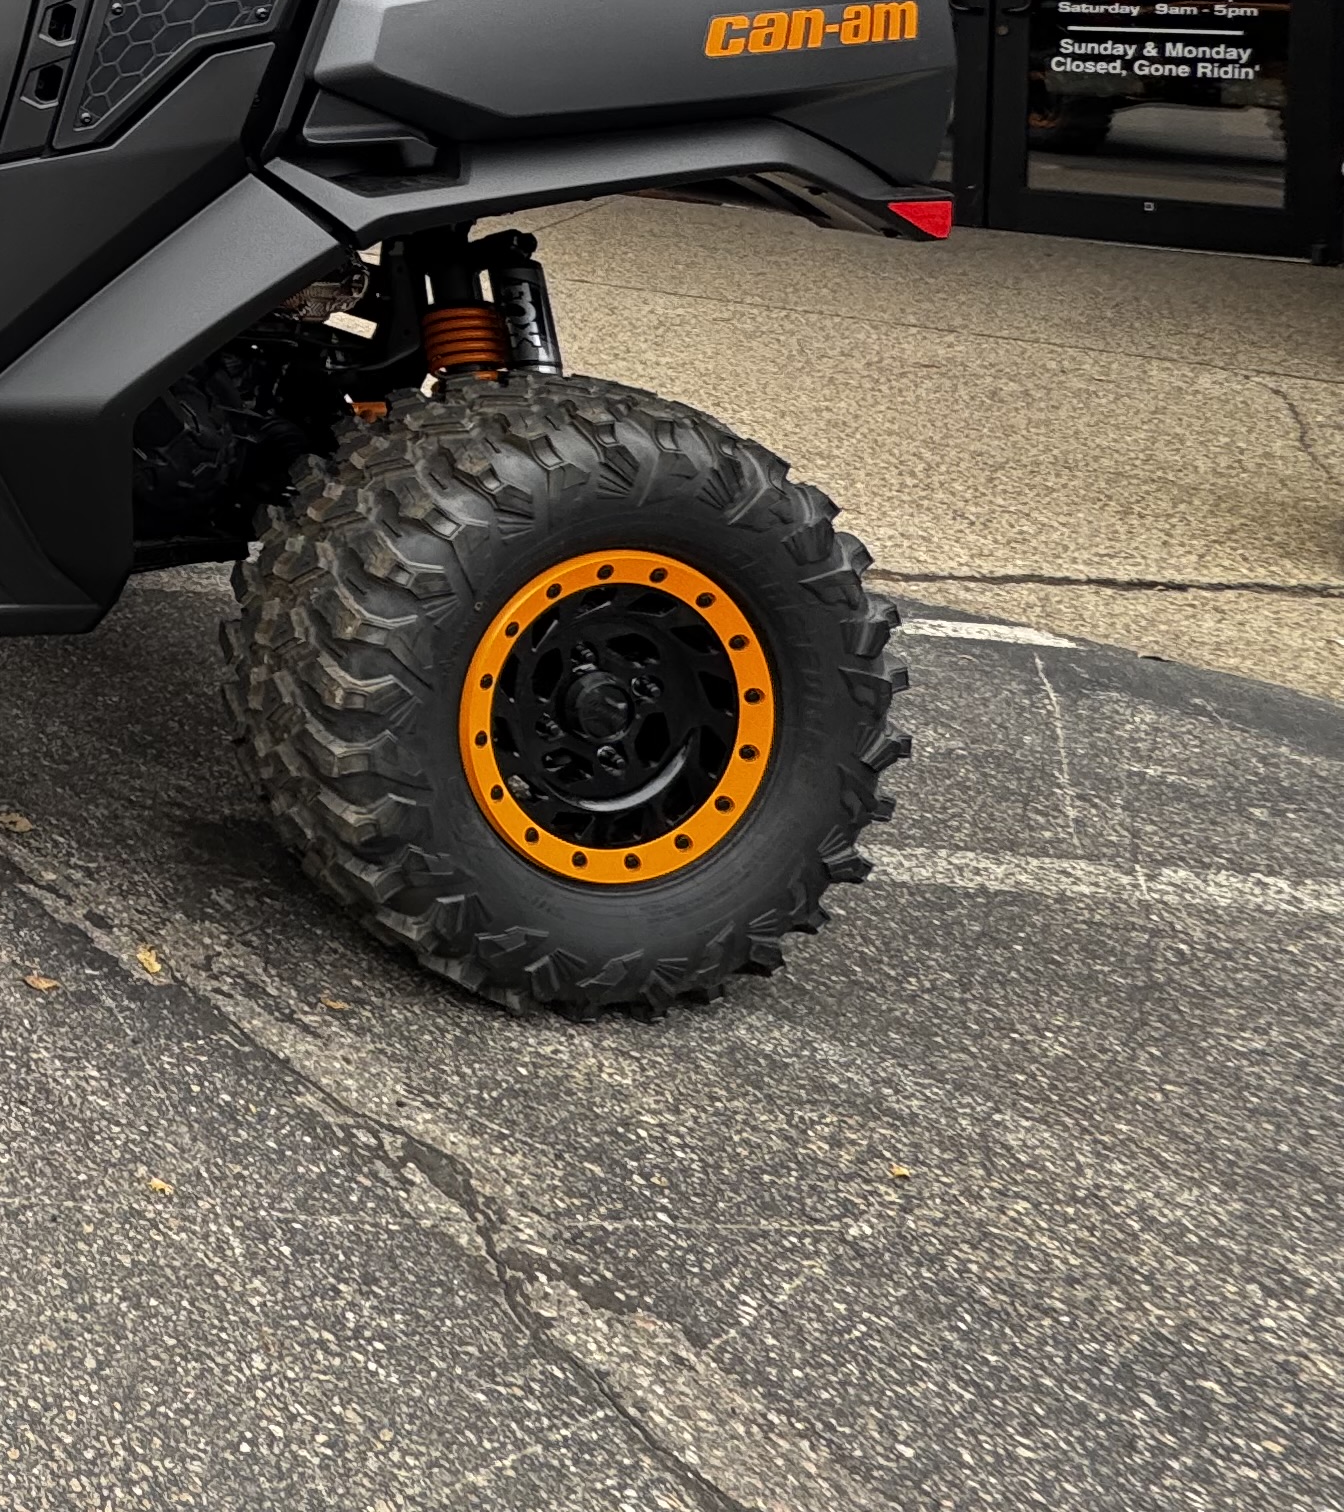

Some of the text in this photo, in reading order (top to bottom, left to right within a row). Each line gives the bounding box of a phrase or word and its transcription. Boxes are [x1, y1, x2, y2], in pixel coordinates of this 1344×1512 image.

[1058, 1, 1140, 16] Saturday
[1155, 4, 1198, 15] 9am
[1214, 4, 1259, 18] 5pm
[705, 0, 918, 57] can-am
[1059, 39, 1252, 63] Sunday & Monday
[1050, 56, 1128, 76] Closed,
[1133, 60, 1191, 77] Gone
[500, 281, 542, 349] FOX
